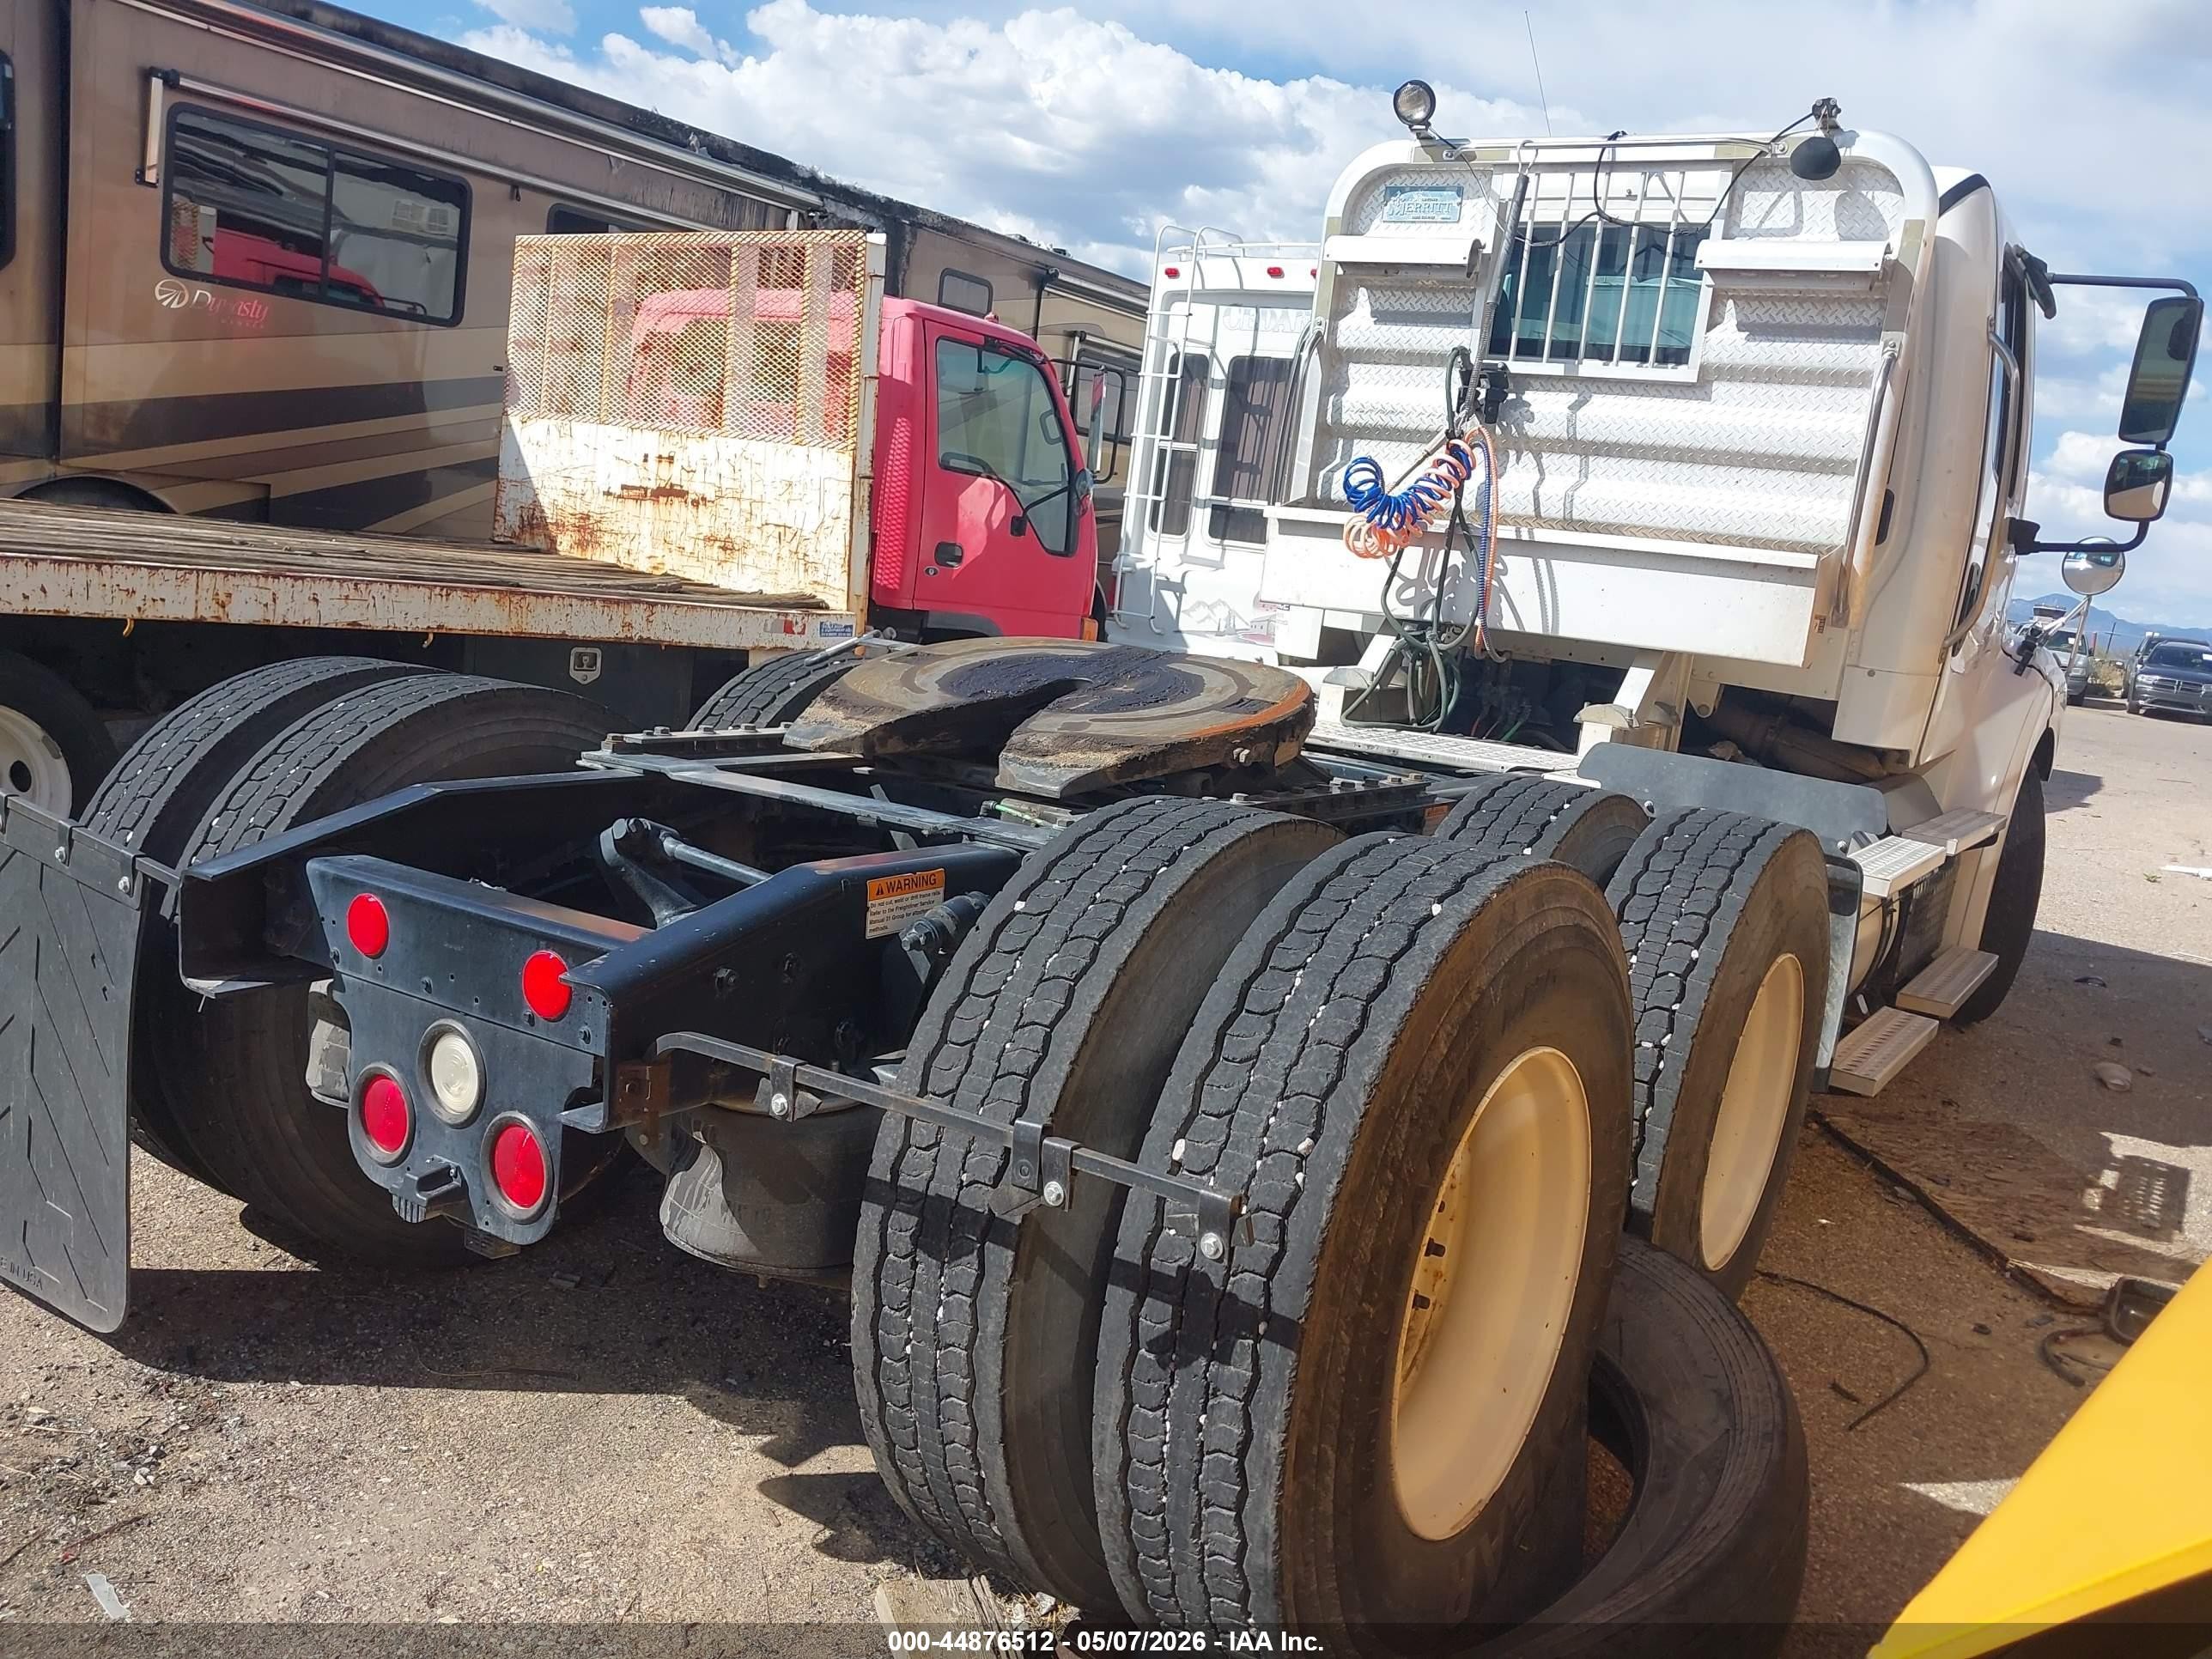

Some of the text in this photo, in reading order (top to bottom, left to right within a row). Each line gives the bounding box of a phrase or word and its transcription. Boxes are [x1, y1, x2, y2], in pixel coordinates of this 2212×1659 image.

[191, 289, 269, 321] Dyasty
[886, 873, 937, 894] WARNING
[23, 1267, 43, 1291] USA
